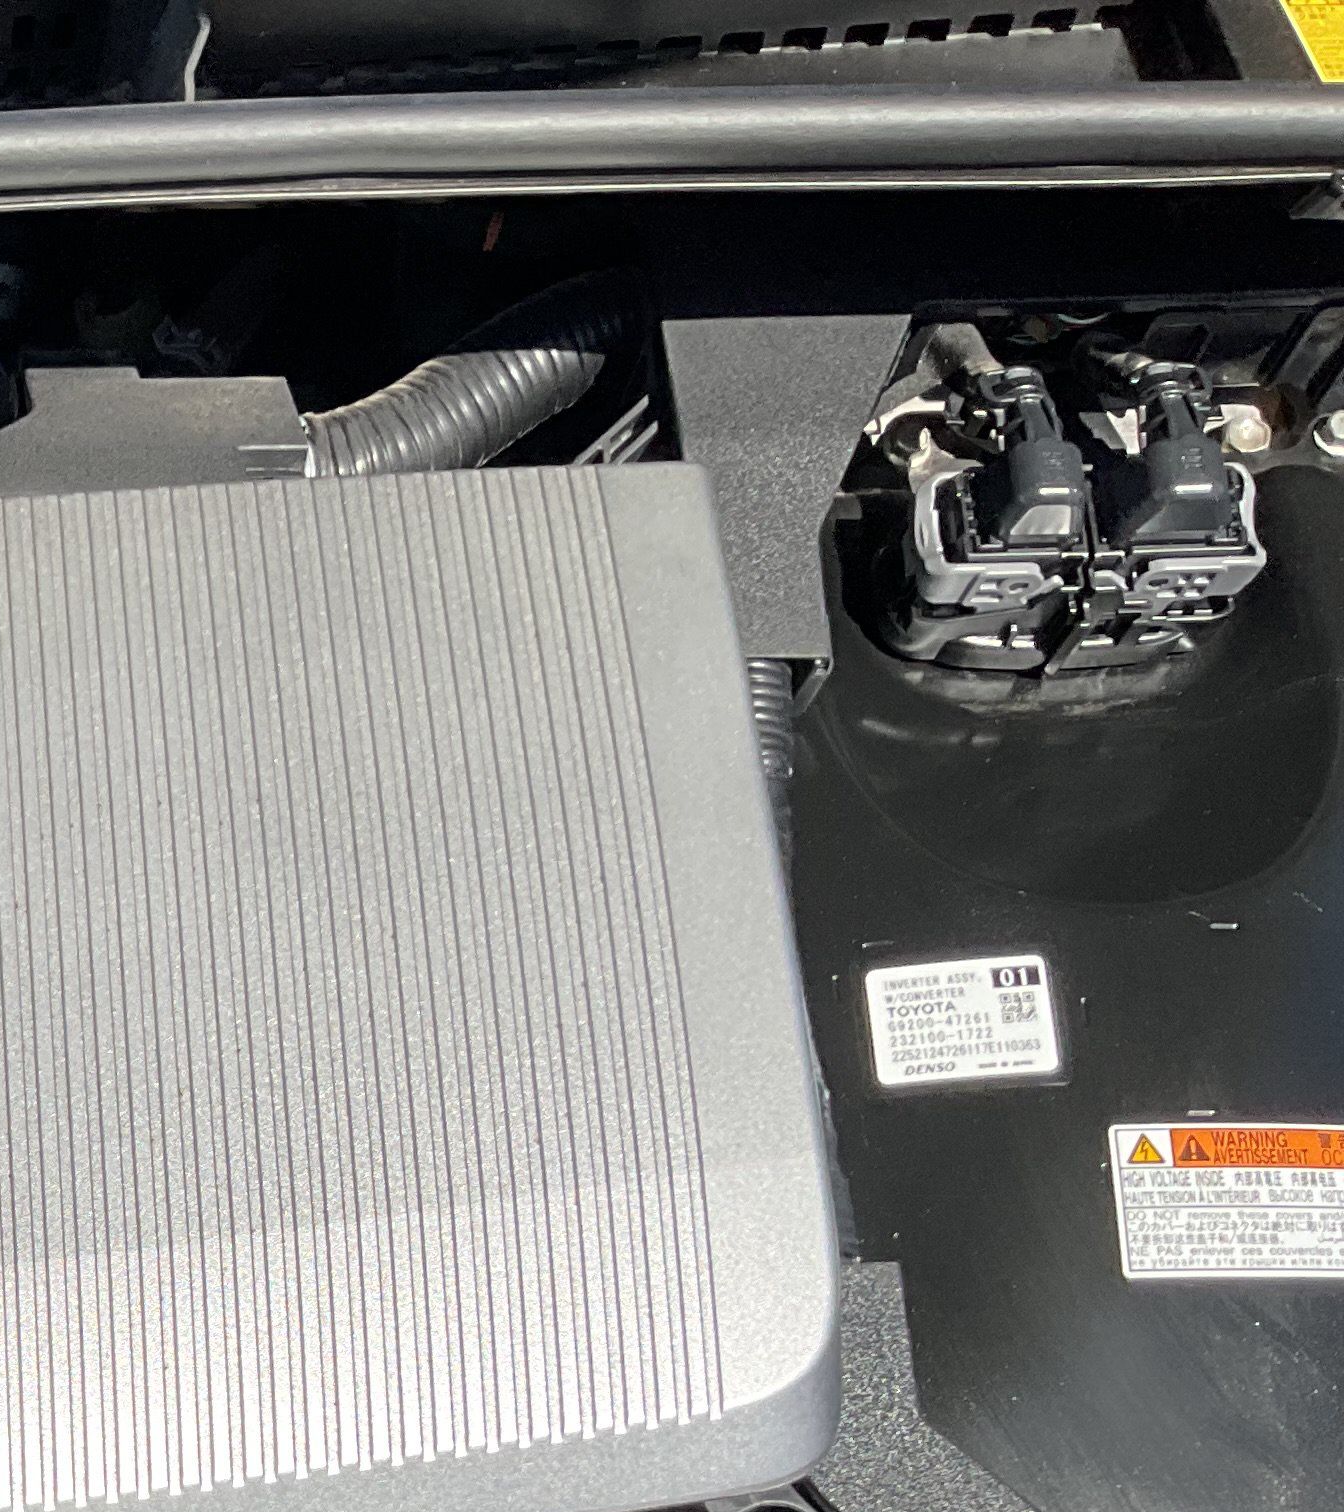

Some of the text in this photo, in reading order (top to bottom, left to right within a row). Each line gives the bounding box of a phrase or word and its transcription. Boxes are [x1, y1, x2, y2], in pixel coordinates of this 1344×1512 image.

[884, 975, 940, 991] INVERTER
[999, 968, 1028, 986] 01
[884, 987, 965, 1003] W/CONVERTER
[887, 1001, 956, 1017] TOYOTA
[888, 1012, 990, 1032] G9200-47261
[890, 1027, 993, 1047] 232100-1722
[904, 1062, 956, 1075] DENSO
[1212, 1132, 1288, 1148] WARNING
[1213, 1149, 1308, 1165] AVERTISSEMENT
[1124, 1171, 1225, 1187] HIGH VOLTAGE INSIDE
[1127, 1211, 1146, 1221] DO
[1154, 1210, 1180, 1220] NOT
[1157, 1246, 1184, 1256] PAS
